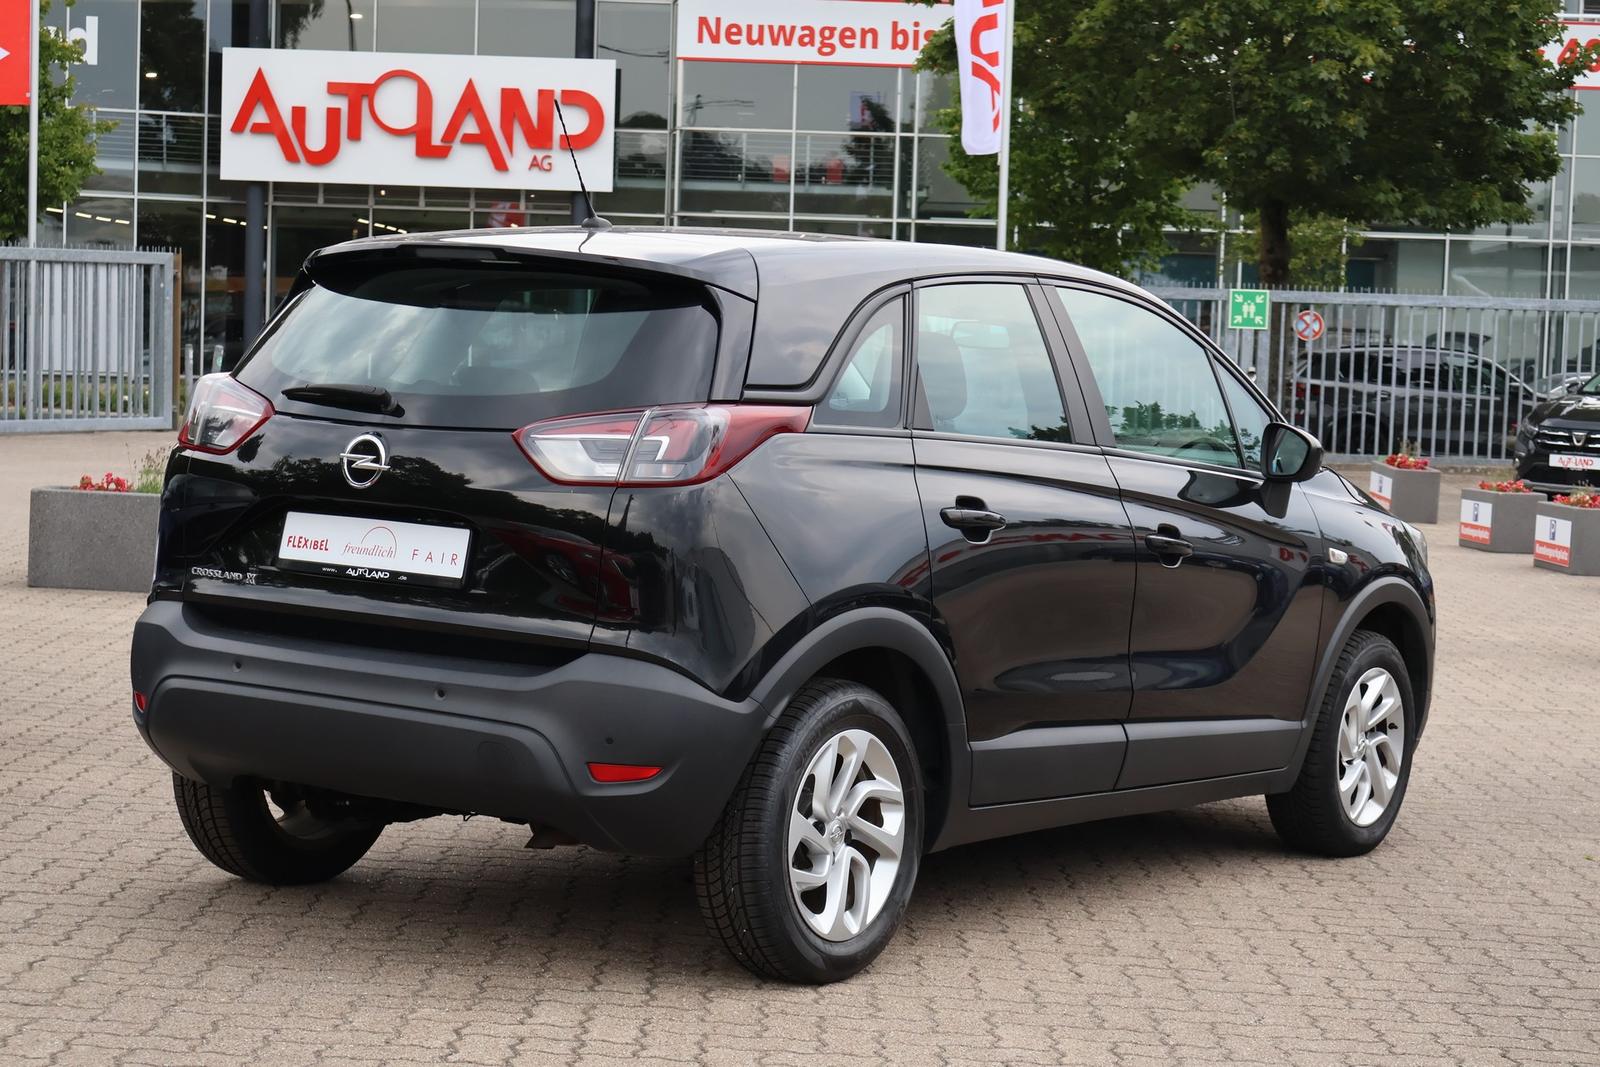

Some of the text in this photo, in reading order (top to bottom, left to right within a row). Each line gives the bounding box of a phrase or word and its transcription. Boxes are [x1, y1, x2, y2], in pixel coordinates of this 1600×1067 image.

[697, 16, 879, 57] Neuwagen
[230, 66, 605, 172] AUTOLAND
[528, 154, 553, 172] AG
[286, 535, 458, 566] FLEXIBEL freundlich FAIR
[191, 566, 243, 580] CROSSLAND
[345, 567, 390, 580] AUTOLAND
